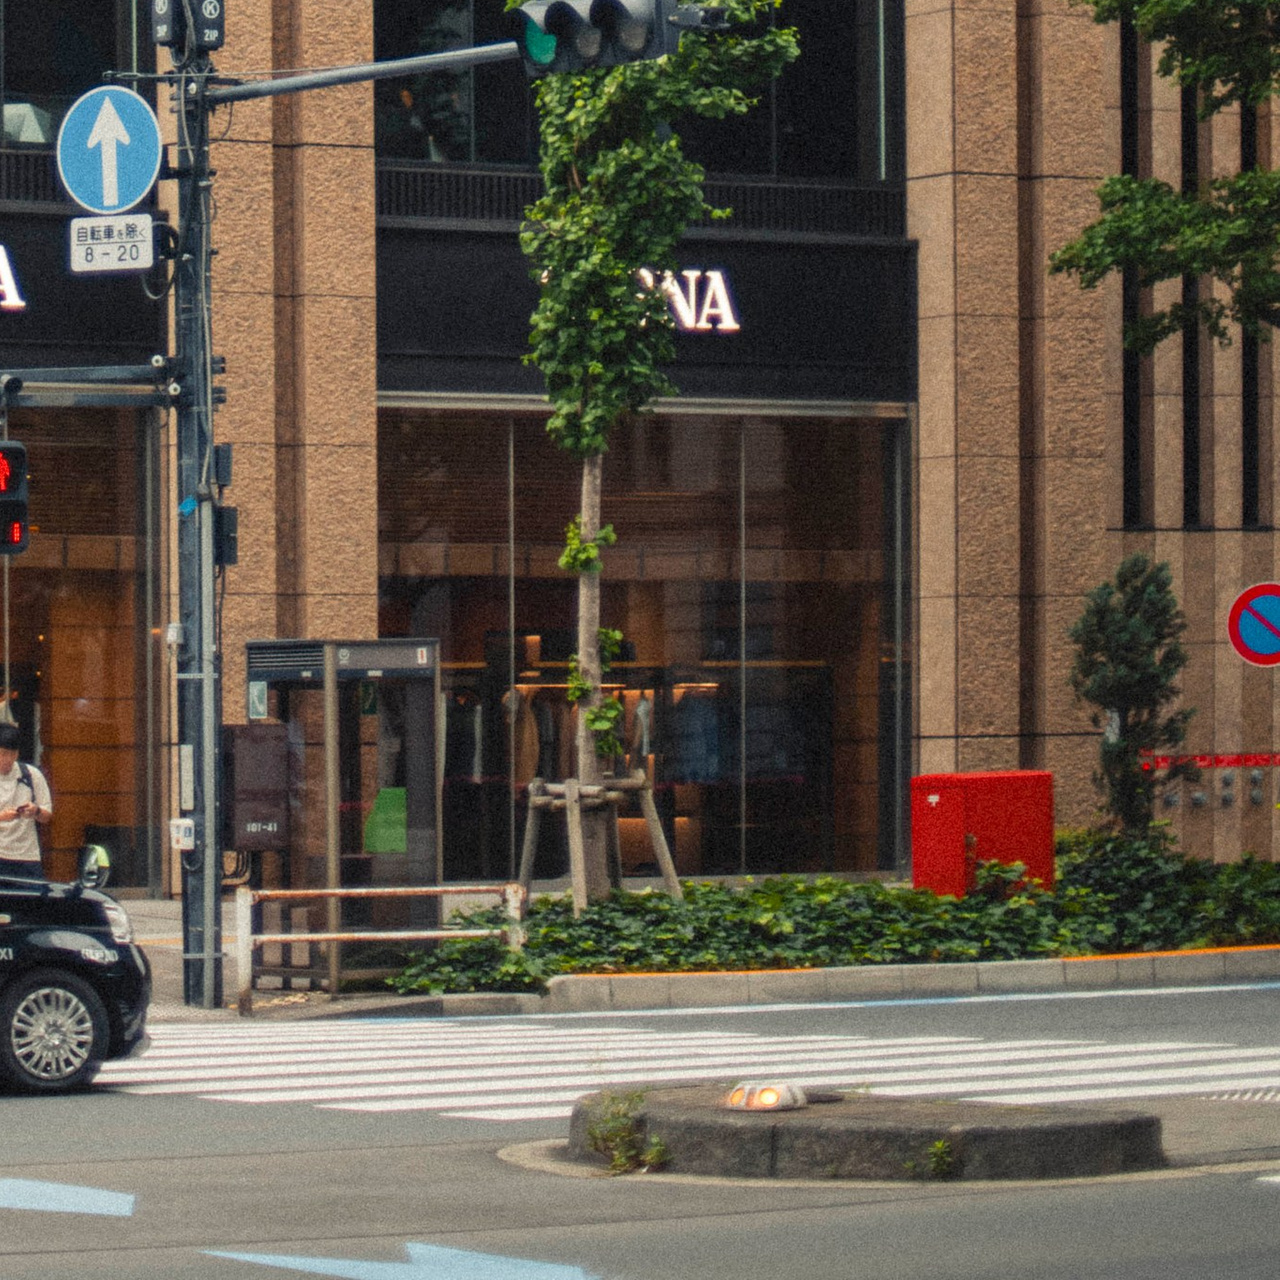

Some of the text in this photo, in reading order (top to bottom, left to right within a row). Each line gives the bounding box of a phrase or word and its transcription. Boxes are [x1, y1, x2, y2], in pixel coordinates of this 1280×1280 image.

[77, 223, 146, 242] 自転車を除く
